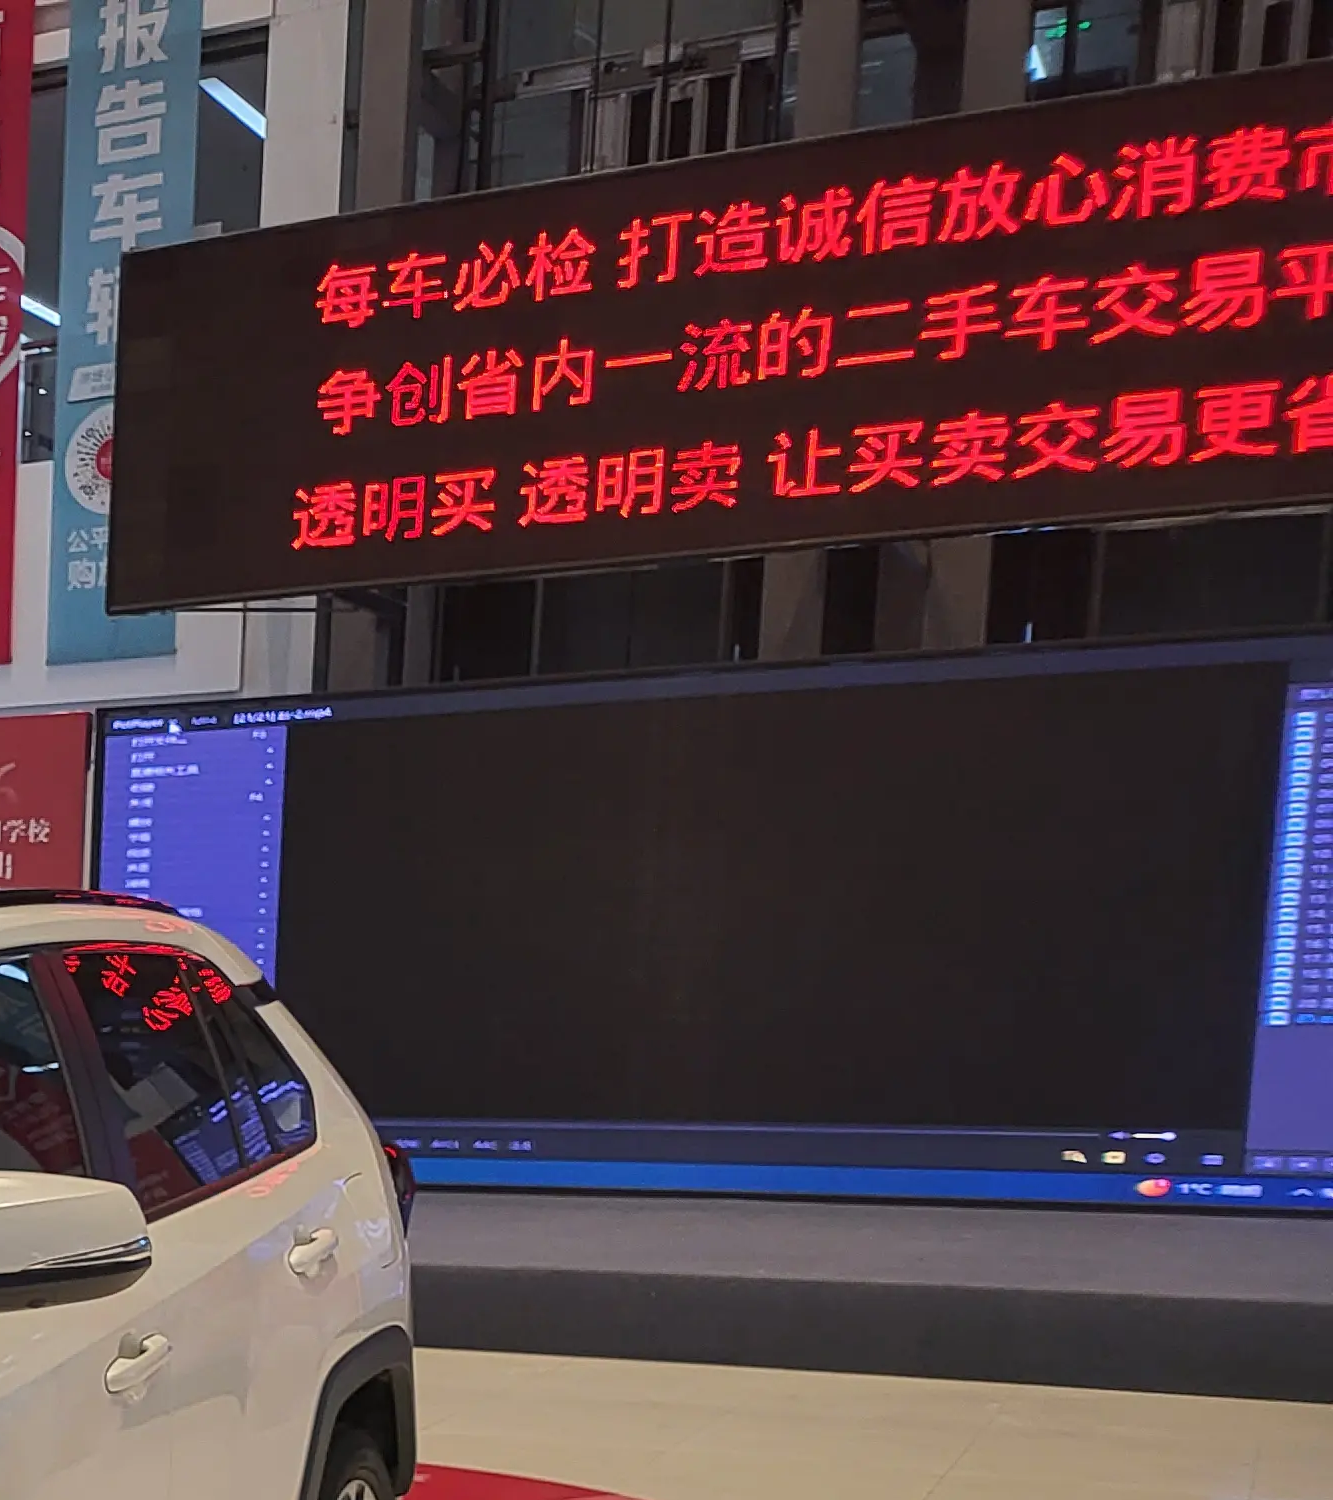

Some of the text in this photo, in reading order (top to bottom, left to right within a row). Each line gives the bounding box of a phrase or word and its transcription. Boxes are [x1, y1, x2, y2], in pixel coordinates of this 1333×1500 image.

[315, 228, 596, 328] 每车必检
[316, 242, 1333, 437] 争创省内一流的二手车交易平
[291, 468, 497, 550] 透明买
[518, 440, 742, 528] 透明卖
[67, 556, 108, 591] 购
